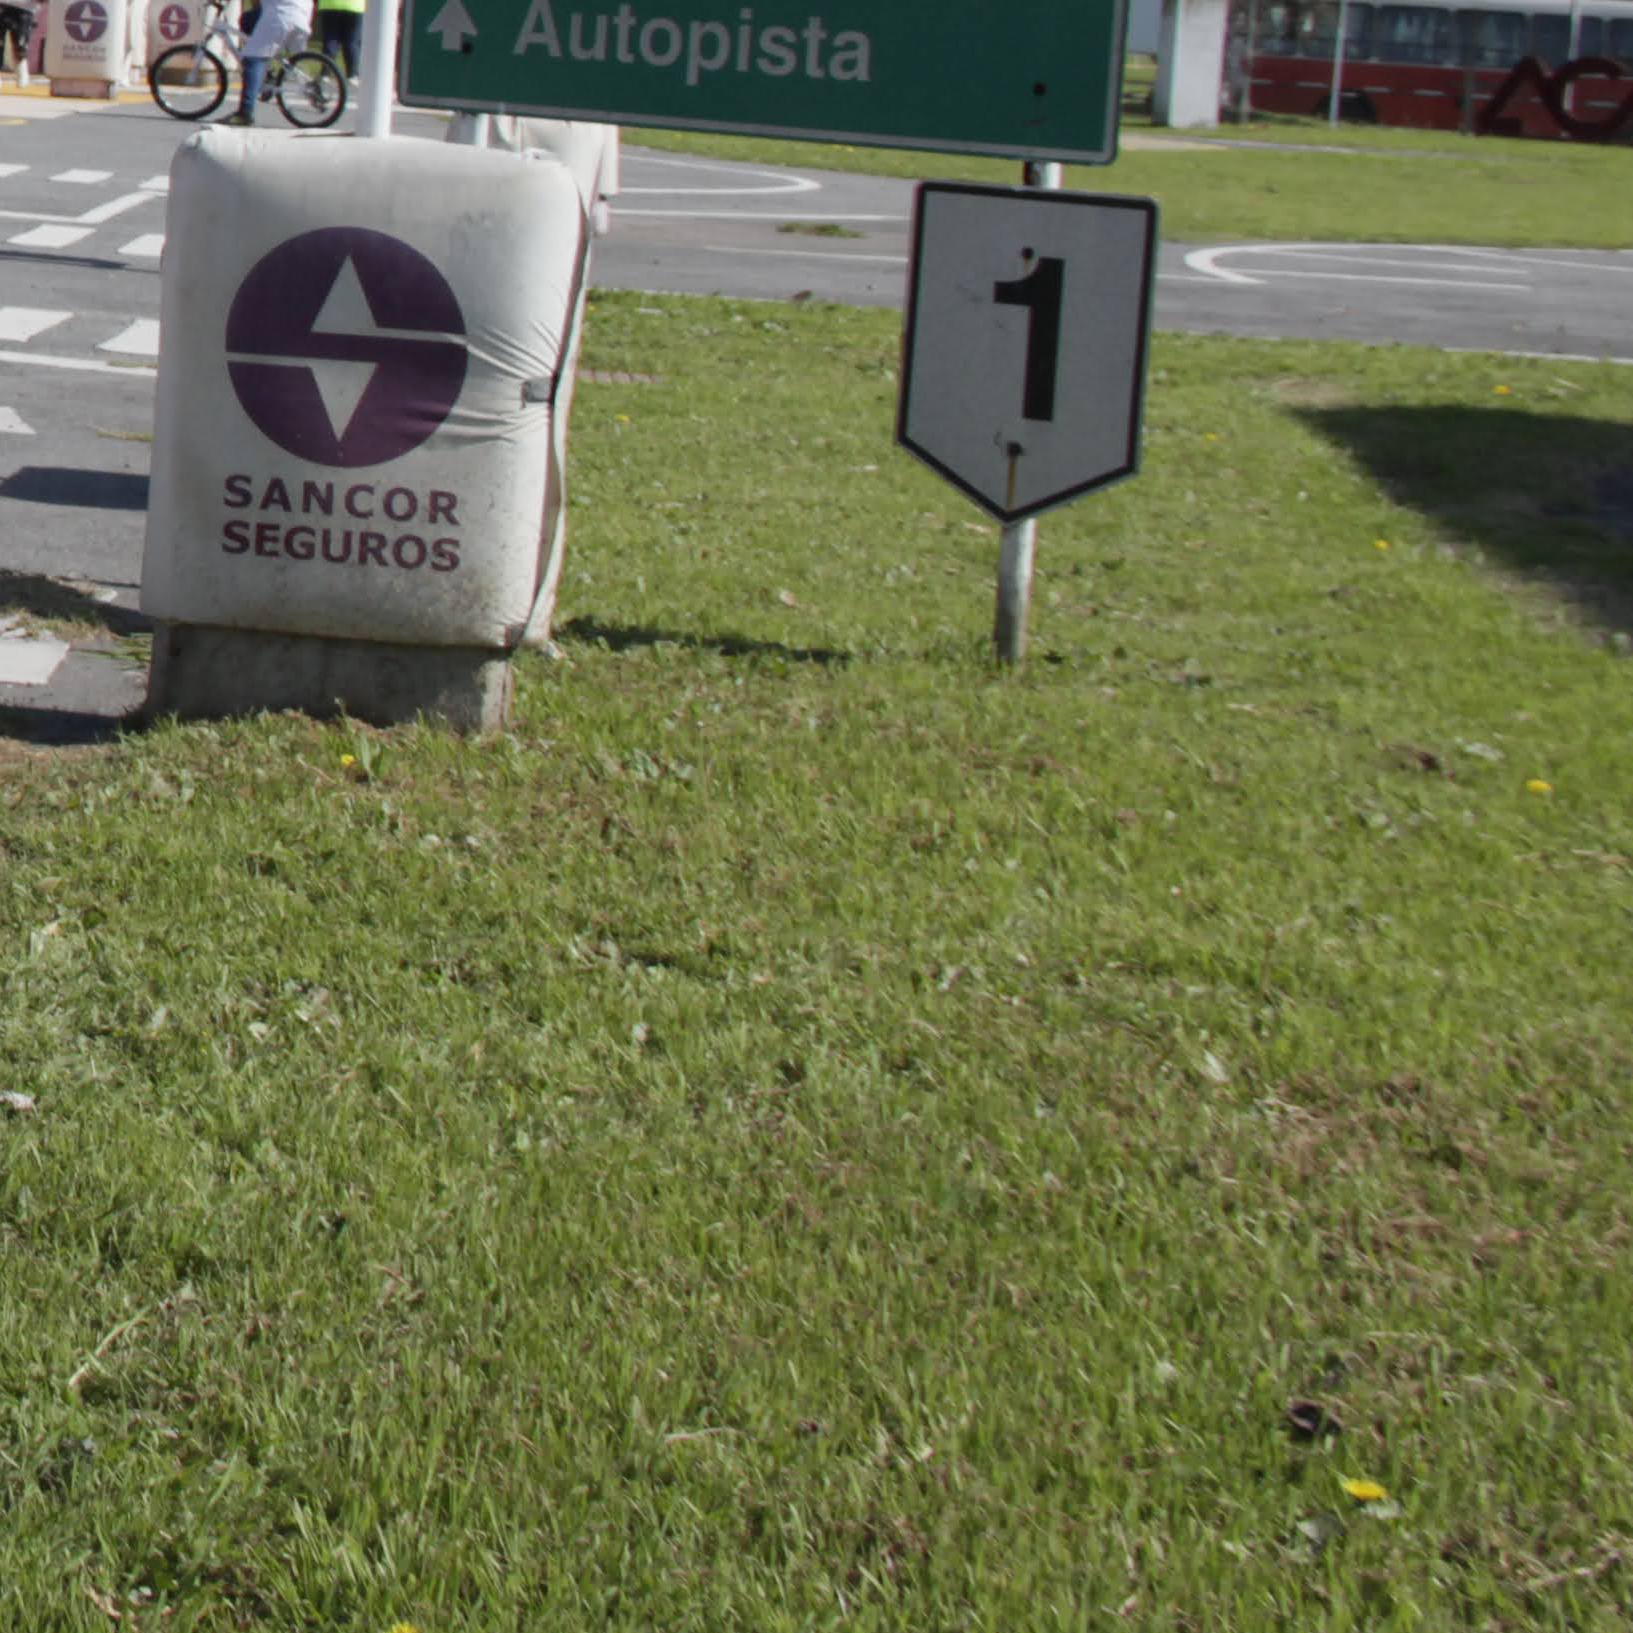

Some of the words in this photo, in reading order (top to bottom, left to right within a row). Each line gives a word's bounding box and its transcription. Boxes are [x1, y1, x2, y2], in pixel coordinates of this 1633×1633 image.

[993, 256, 1064, 421] 1
[224, 475, 461, 525] SANCOR
[222, 521, 462, 572] SEGUROS
